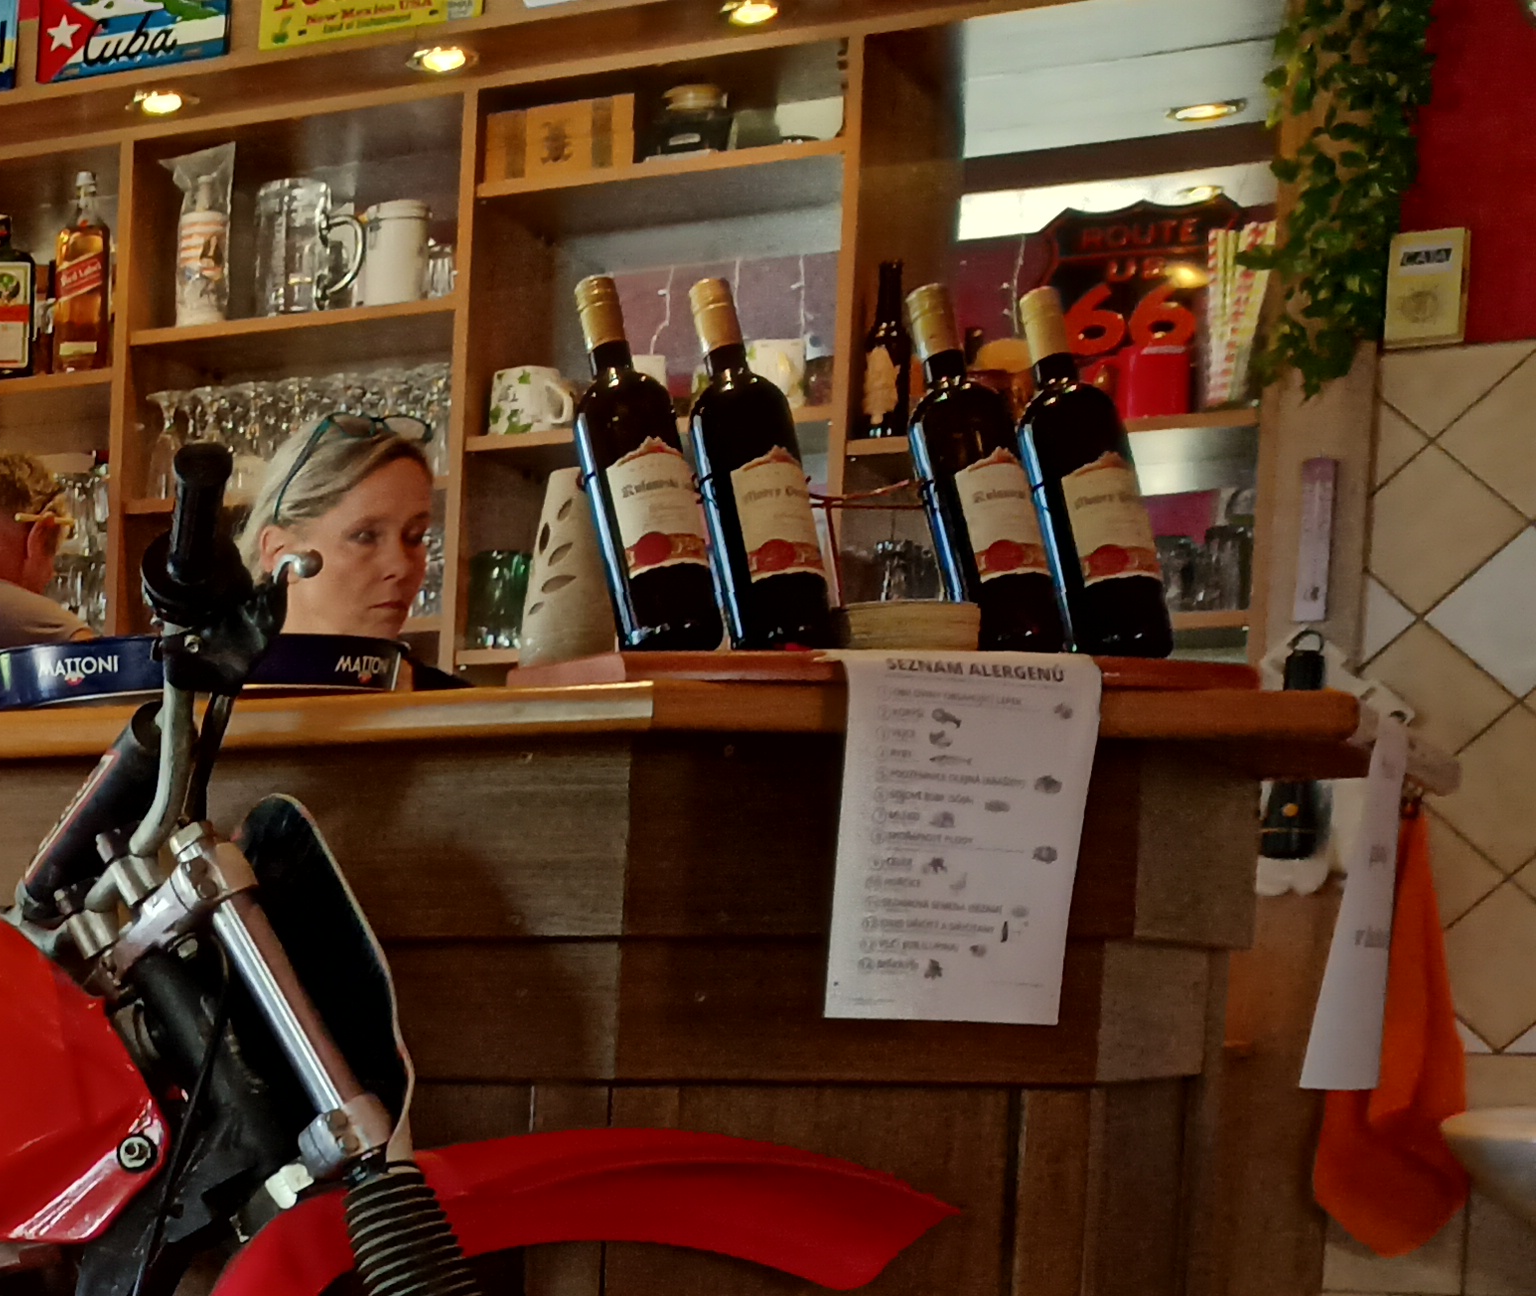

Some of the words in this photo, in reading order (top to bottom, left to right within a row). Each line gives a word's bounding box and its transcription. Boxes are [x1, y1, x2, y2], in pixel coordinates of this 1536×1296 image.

[83, 11, 178, 66] Cuba
[1081, 217, 1199, 250] ROUTE
[1064, 283, 1196, 356] 66
[37, 654, 119, 678] MATTONI
[885, 657, 964, 676] SEZNAM
